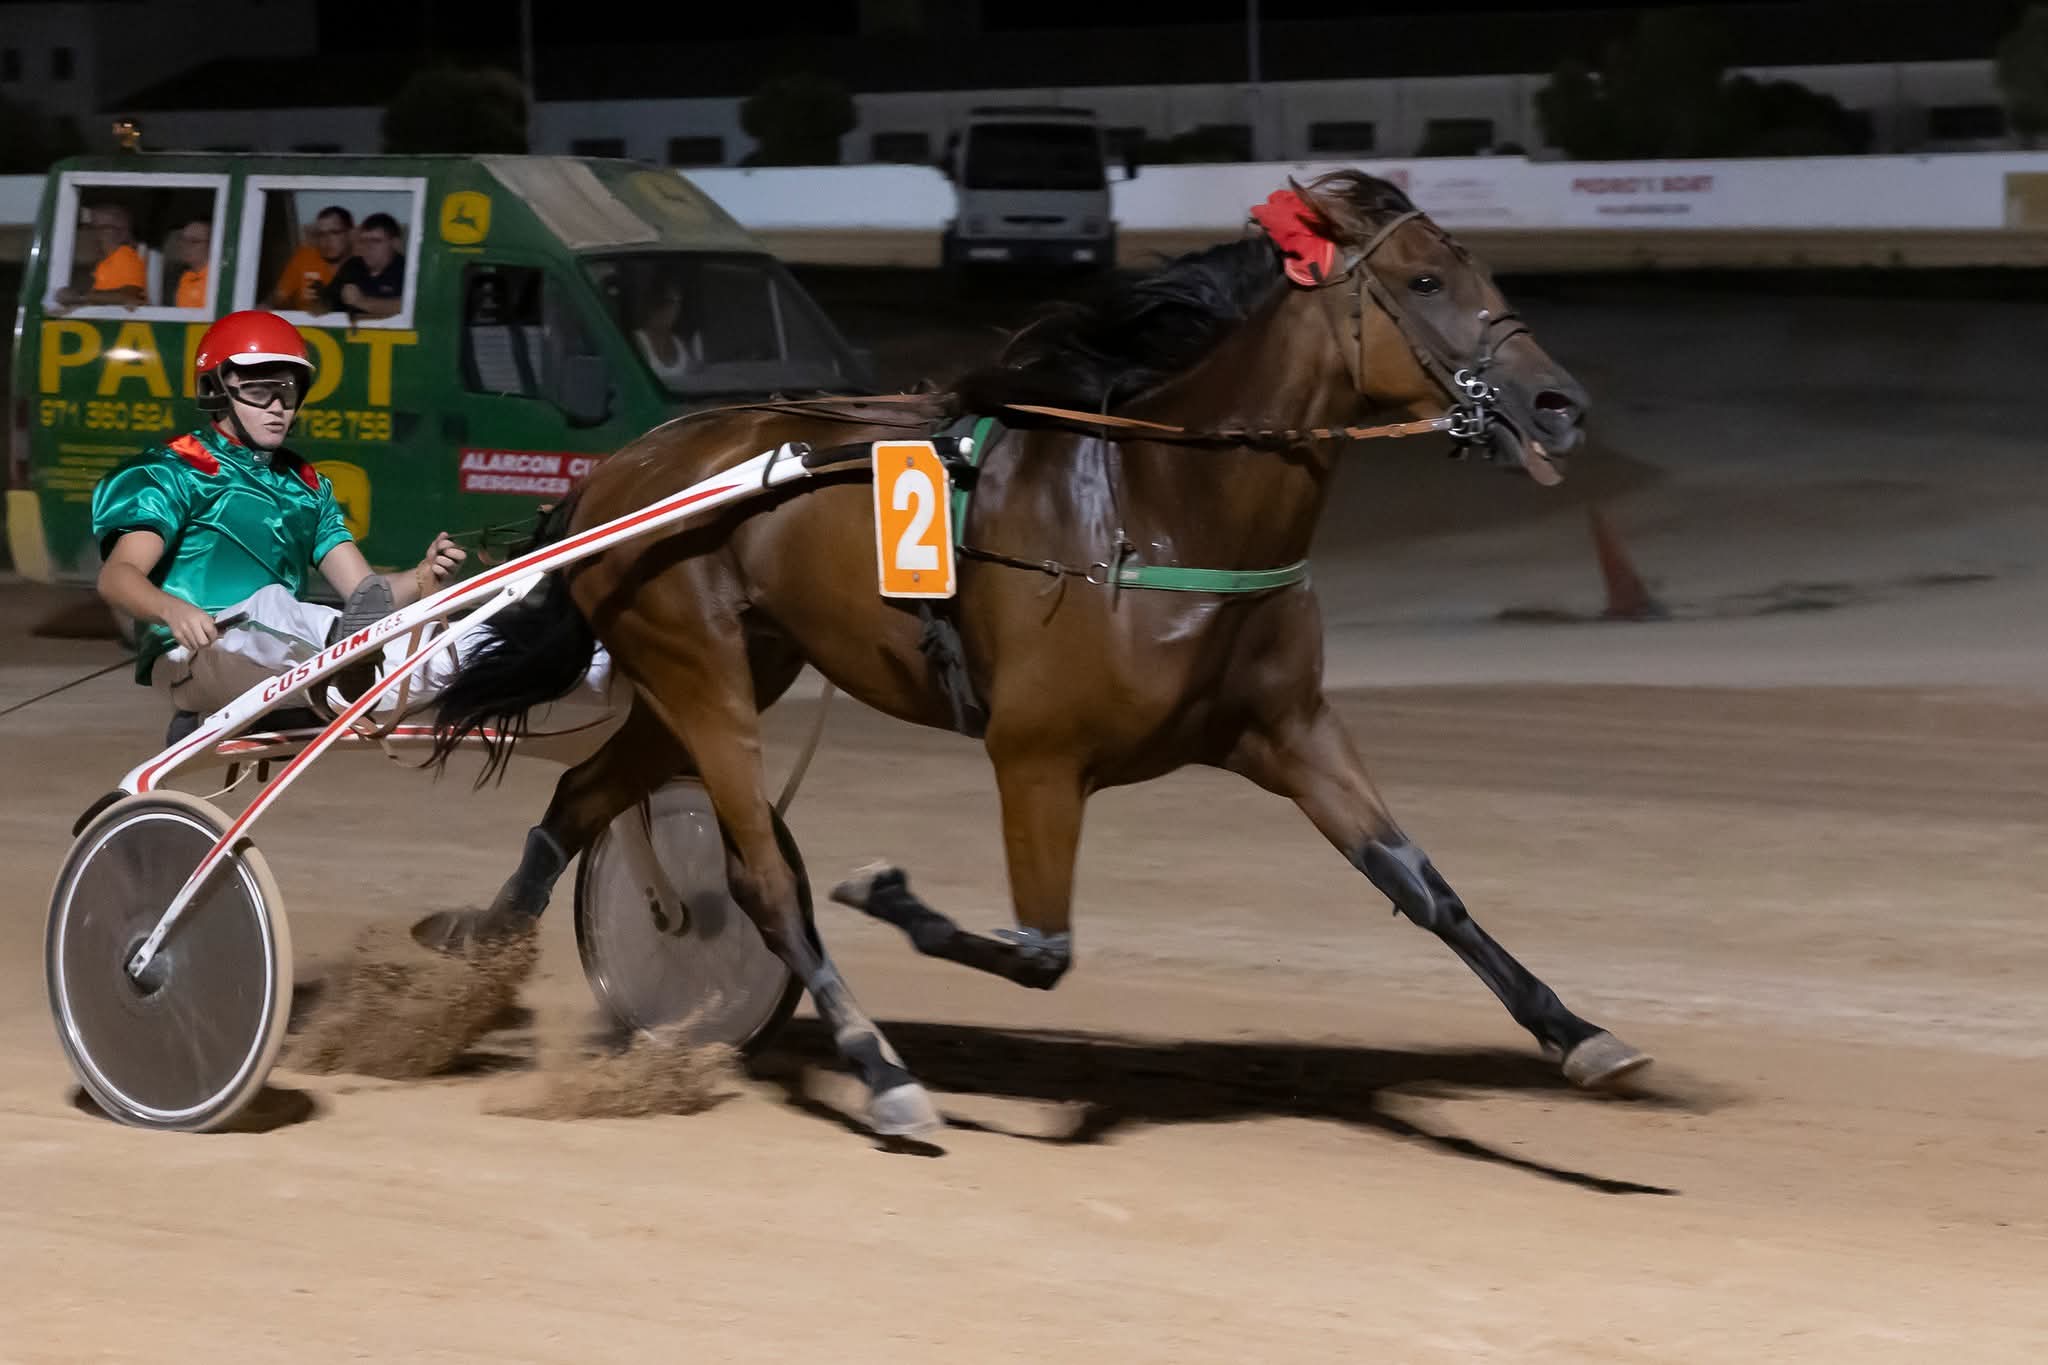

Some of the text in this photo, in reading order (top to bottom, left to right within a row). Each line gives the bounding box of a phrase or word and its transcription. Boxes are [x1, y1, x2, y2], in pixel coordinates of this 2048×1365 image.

[461, 452, 561, 474] ALARCON
[892, 469, 939, 570] 2
[263, 628, 372, 703] CUSTOM
